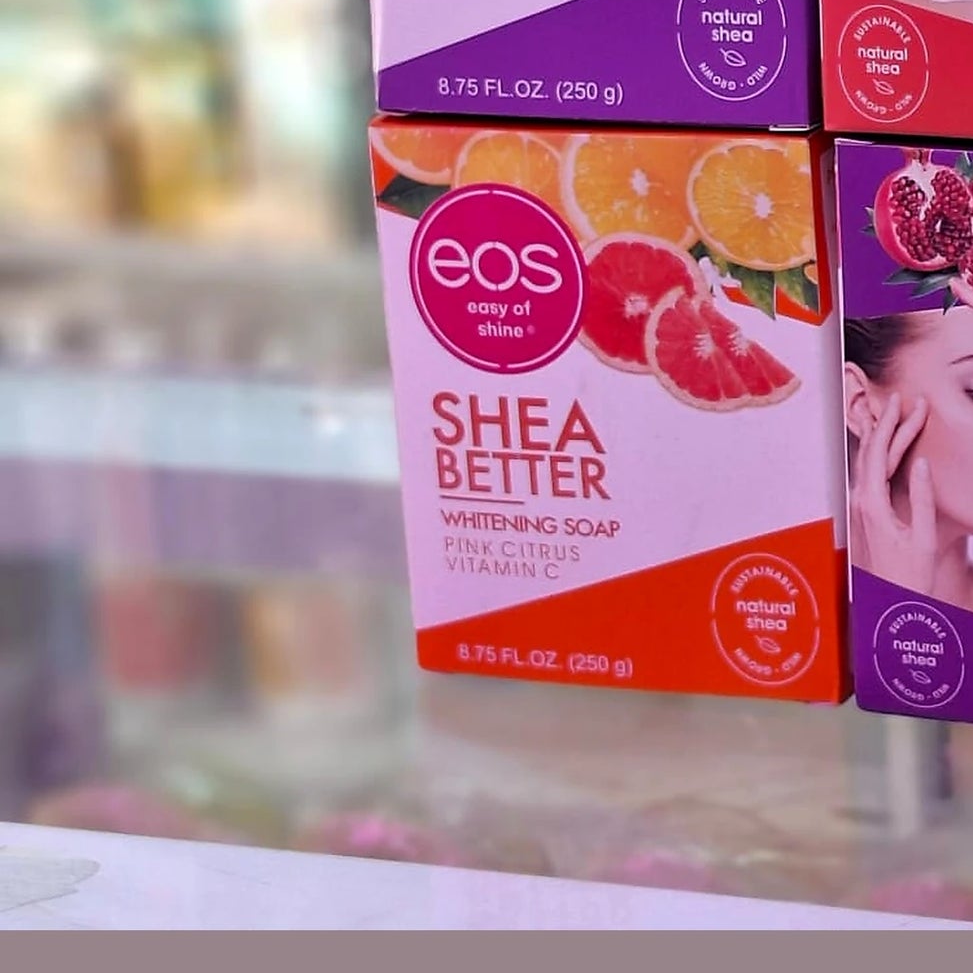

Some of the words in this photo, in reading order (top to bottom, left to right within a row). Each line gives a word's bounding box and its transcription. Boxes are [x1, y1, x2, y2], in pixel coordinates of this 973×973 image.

[702, 9, 763, 26] natural
[711, 27, 753, 43] shea
[854, 16, 912, 44] SUSTAINABLE
[857, 45, 908, 62] natural
[865, 60, 900, 75] shea
[438, 78, 479, 97] 8.75
[484, 80, 549, 101] FL.OZ.
[555, 80, 598, 102] (250
[604, 83, 624, 105] g)
[427, 238, 563, 294] eos
[467, 300, 512, 319] easy
[513, 299, 531, 316] of
[431, 392, 606, 455] SHEA
[437, 447, 611, 500] BETTER
[441, 510, 558, 534] WHITENING
[563, 518, 621, 538] SOAP
[444, 536, 494, 555] PINK
[500, 540, 580, 562] CITRUS
[446, 555, 540, 578] VITAMIN
[545, 561, 560, 580] C
[736, 597, 796, 615] natural
[745, 614, 787, 631] shea
[893, 639, 943, 655] natural
[458, 643, 497, 661] 8.75
[569, 651, 609, 675] (250
[614, 656, 633, 678] g)
[902, 652, 936, 666] shea
